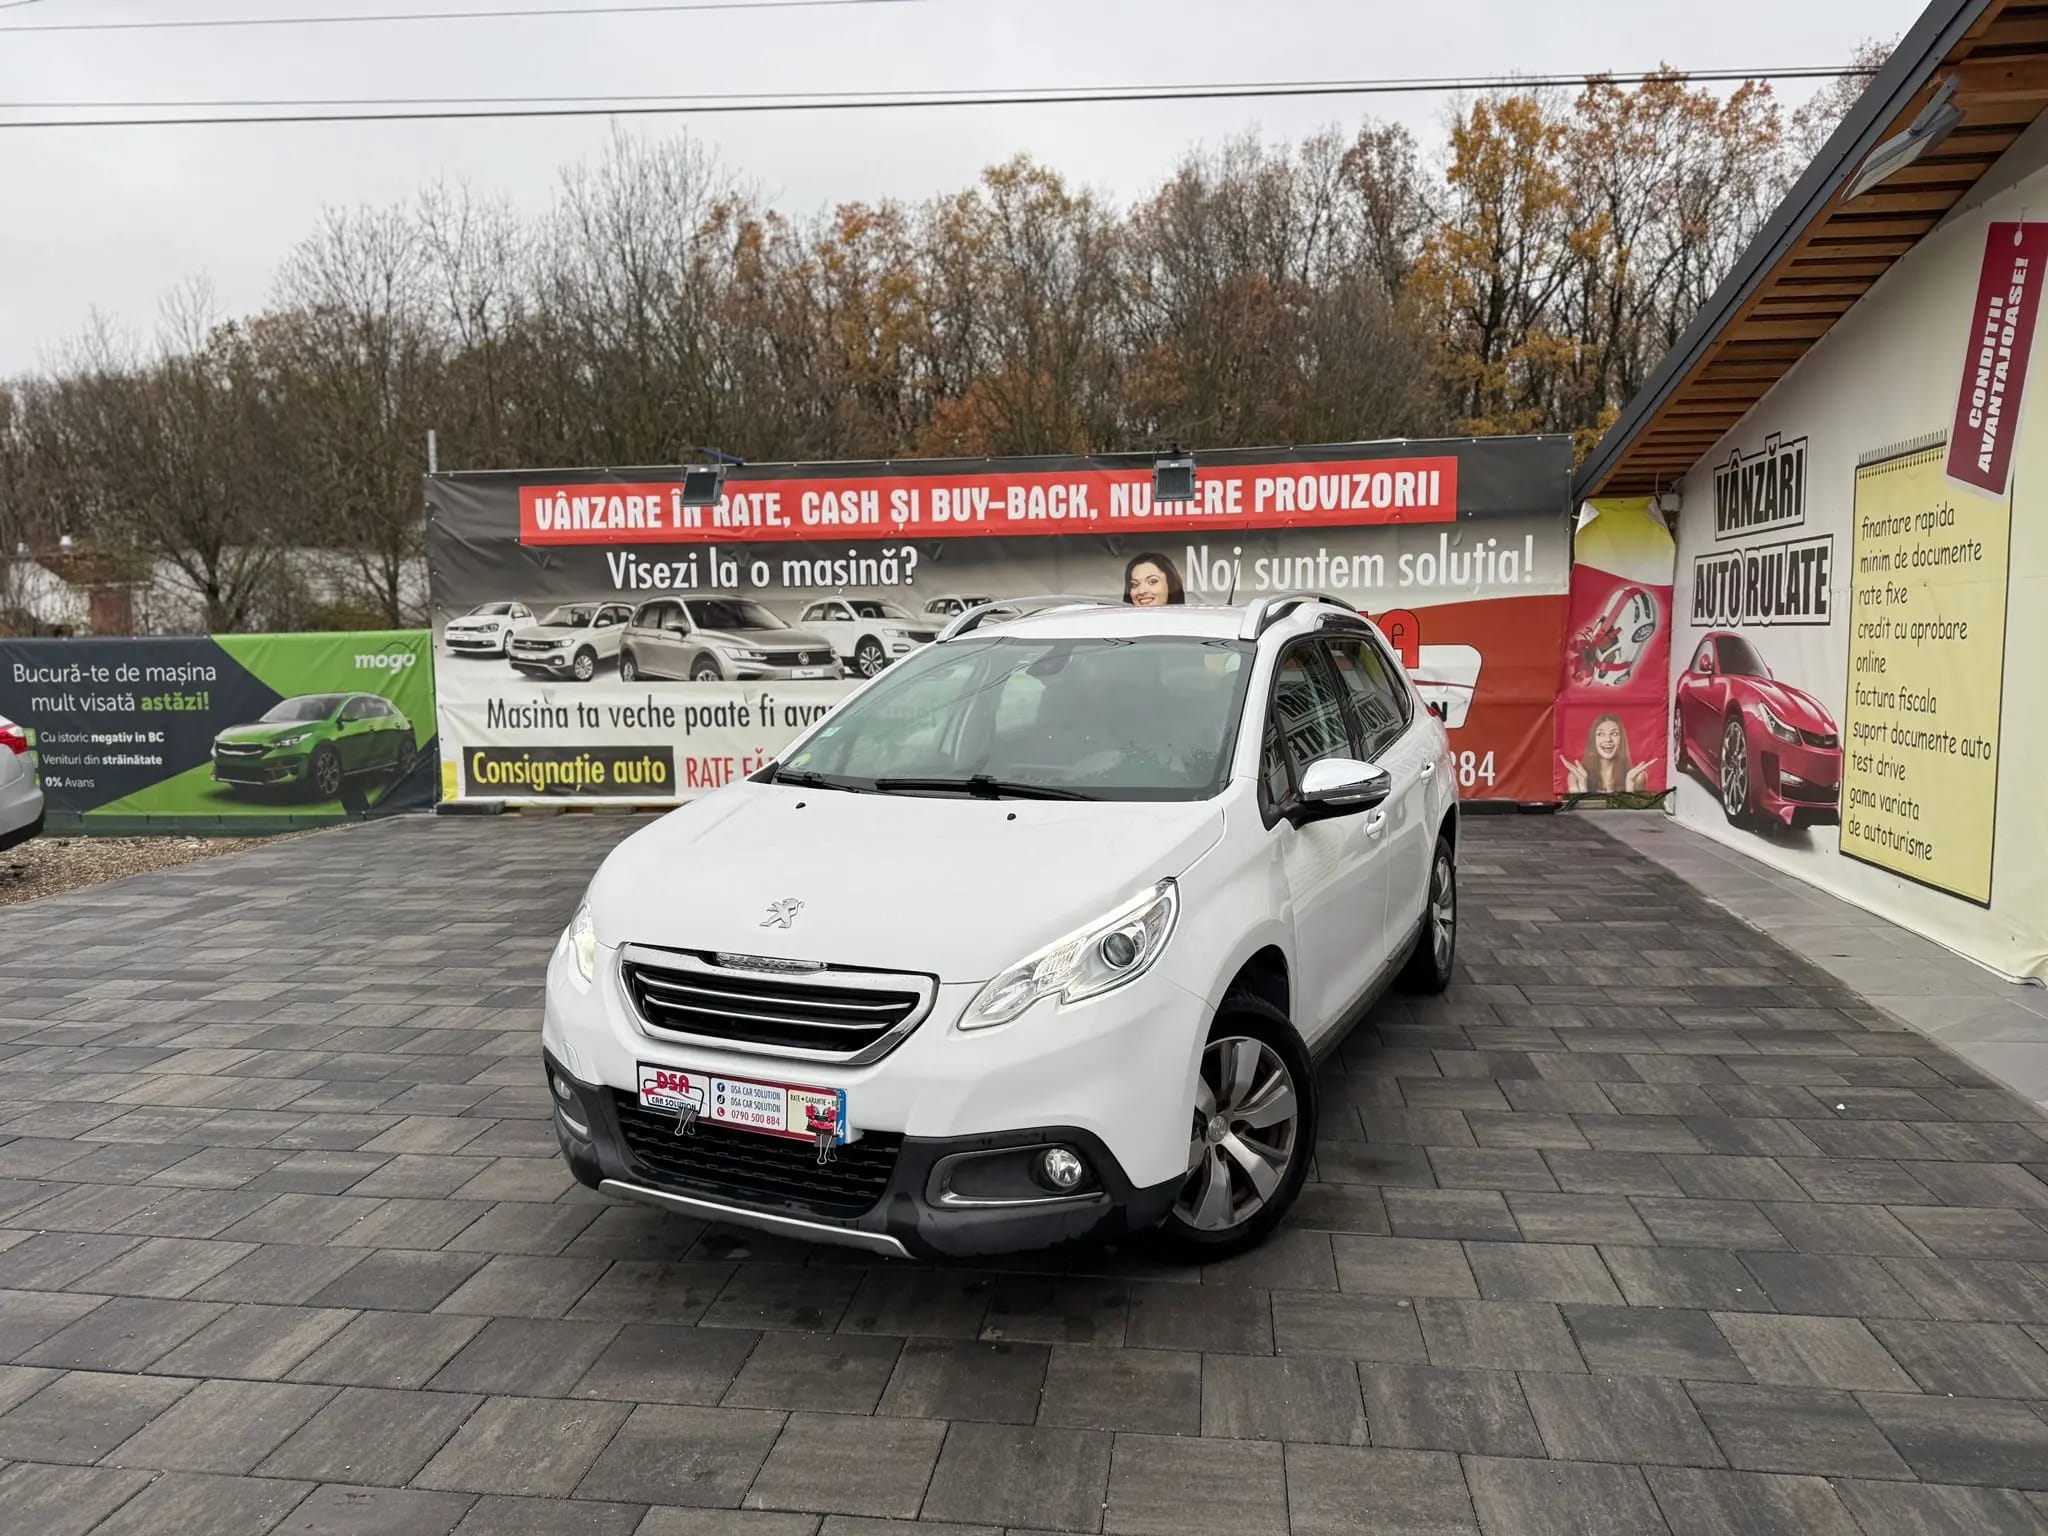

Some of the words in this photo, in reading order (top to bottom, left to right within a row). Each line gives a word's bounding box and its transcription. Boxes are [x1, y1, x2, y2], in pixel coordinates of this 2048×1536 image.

[1968, 296, 2003, 428] CONDITII
[1977, 257, 2029, 475] AVANTAJOASE!
[535, 491, 662, 530] VÂNZARE
[671, 488, 701, 529] ÎN
[712, 492, 791, 529] RATE,
[801, 490, 880, 526] CASH
[890, 489, 920, 531] ȘI
[931, 483, 1098, 523] BUY-BACK,
[1110, 479, 1242, 518] NUERE
[1255, 471, 1440, 513] PROVIZORII
[1716, 443, 1803, 532] VÂNZĂRI
[1862, 514, 1911, 541] finantare
[1915, 501, 1955, 537] rapida
[606, 552, 698, 589] Visezi
[709, 547, 738, 588] la
[751, 561, 770, 588] o
[1186, 545, 1242, 593] Noi
[1254, 548, 1384, 590] suntem
[1399, 533, 1533, 594] soluția!
[1861, 549, 1890, 574] minim
[1894, 544, 1908, 569] de
[1911, 538, 1982, 568] documente
[1694, 558, 1742, 619] AUTO
[1746, 546, 1828, 617] RULATE
[1859, 585, 1882, 606] rate
[1886, 580, 1908, 606] fixe
[1858, 616, 1891, 640] credit
[1894, 622, 1907, 640] cu
[1910, 614, 1968, 647] aprobare
[13, 663, 110, 683] Bucură-te
[115, 663, 140, 682] de
[146, 662, 217, 686] mașina
[354, 654, 416, 675] mogo
[1856, 649, 1886, 673] online
[31, 693, 78, 712] mult
[80, 692, 135, 712] visată
[141, 691, 209, 711] astăzi!
[487, 698, 568, 729] Masina
[577, 702, 600, 728] ta
[608, 694, 675, 728] veche
[685, 701, 750, 735] poate
[759, 693, 775, 727] fi
[1855, 682, 1895, 710] factura
[1898, 686, 1937, 714] fiscala
[40, 731, 56, 743] Cu
[58, 731, 89, 743] istoric
[91, 731, 132, 746] negativ
[148, 732, 165, 743] BC
[1852, 721, 1887, 746] suport
[1891, 721, 1957, 755] documente
[1961, 735, 1991, 760] auto
[42, 754, 82, 765] Venituri
[84, 754, 100, 765] din
[102, 753, 162, 765] străinătate
[472, 752, 604, 792] Consignație
[613, 755, 666, 784] auto
[1852, 750, 1874, 774] test
[1876, 753, 1906, 780] drive
[45, 776, 62, 788] 0%
[65, 777, 95, 788] Avans
[1849, 786, 1876, 809] gama
[1879, 793, 1920, 820] variata
[1848, 813, 1861, 837] de
[1864, 823, 1933, 861] autoturisme
[656, 1071, 689, 1094] DSA
[731, 1085, 741, 1094] DSA
[743, 1087, 753, 1096] CAR
[754, 1089, 780, 1100] SOLUTION
[790, 1094, 800, 1102] RATE
[652, 1096, 664, 1105] CAR
[665, 1099, 696, 1110] SOLUTION
[731, 1097, 741, 1106] DSA
[743, 1099, 753, 1109] CAR
[754, 1101, 780, 1113] SOLUTION
[731, 1109, 749, 1121] 0790
[751, 1113, 765, 1124] 500
[766, 1115, 780, 1127] 884
